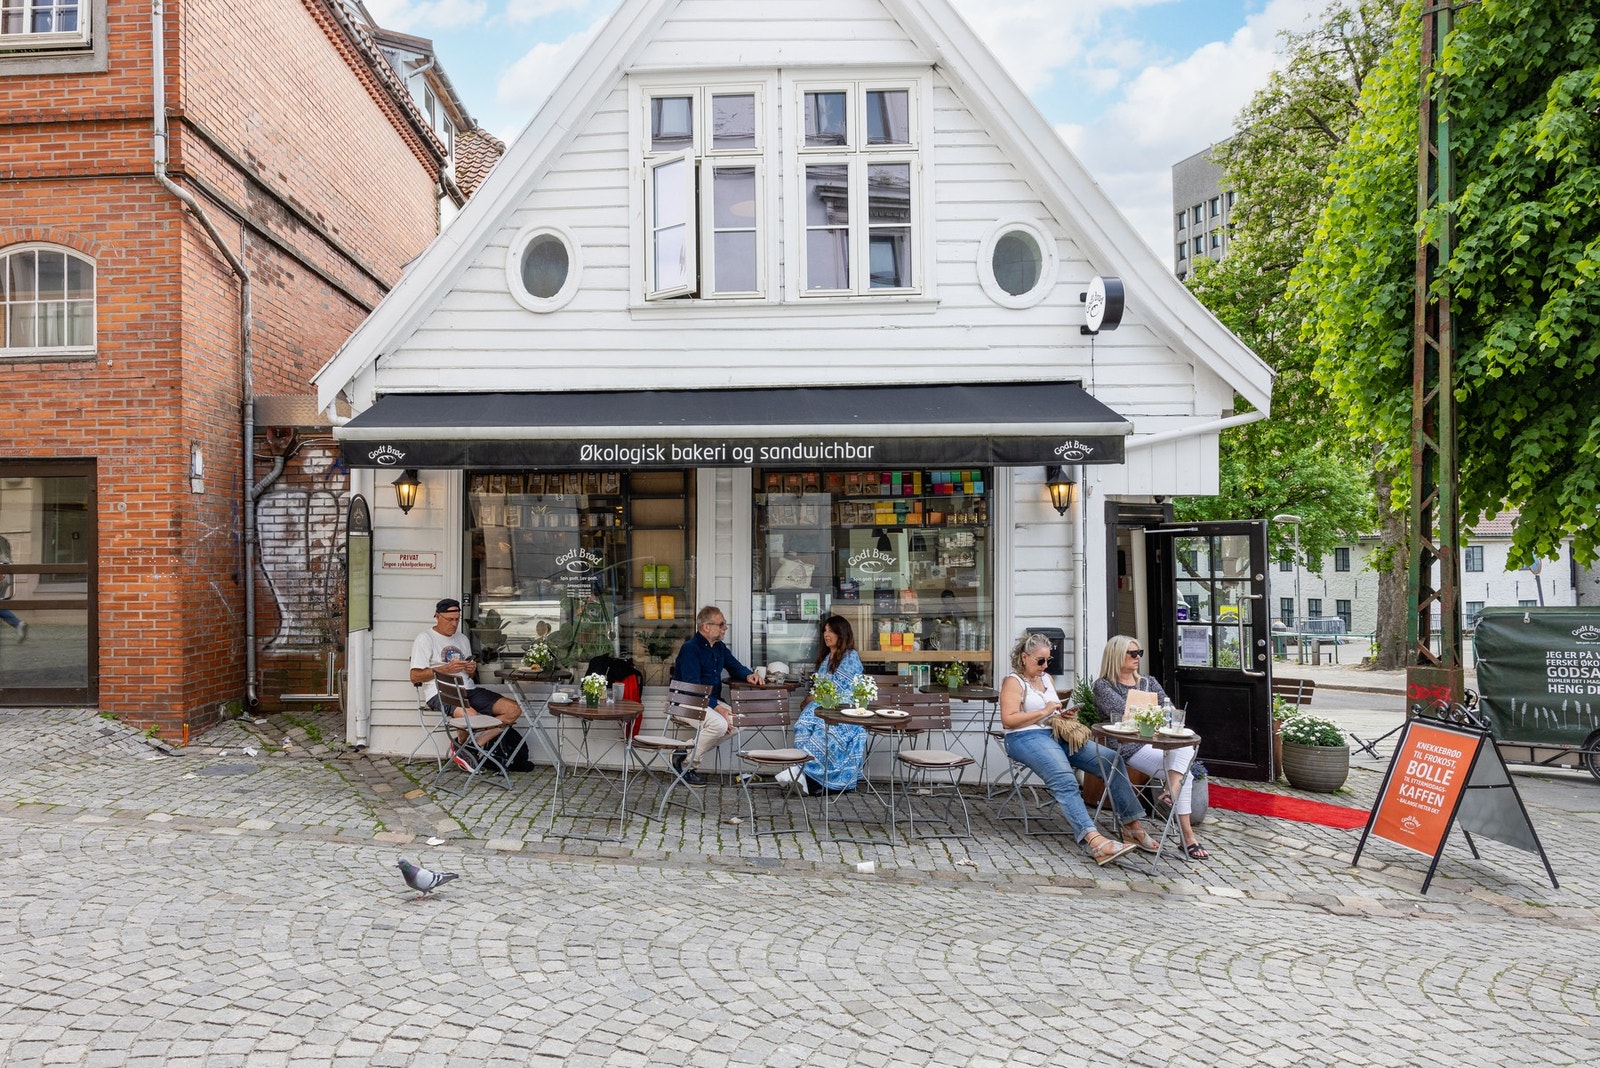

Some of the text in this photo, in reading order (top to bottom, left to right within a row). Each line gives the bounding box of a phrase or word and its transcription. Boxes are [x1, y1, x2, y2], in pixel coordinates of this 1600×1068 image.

[368, 445, 406, 459] Godt Brød
[580, 442, 875, 464] Økologisk bakeri og sandwichbar
[1054, 440, 1094, 455] Godt Brød
[555, 547, 603, 566] Godt Brød
[848, 547, 897, 566] Godt Brød
[1572, 625, 1588, 636] Godt
[1545, 651, 1562, 659] JEG
[1564, 651, 1577, 659] ER
[1579, 650, 1593, 659] PÅ
[1546, 659, 1600, 667] FERSKE ØKO
[1547, 666, 1600, 678] GODSA
[1548, 684, 1583, 695] HENG
[1416, 741, 1462, 759] KNEKKEBRØD
[1413, 750, 1456, 769] TIL FROKOST,
[1406, 760, 1454, 786] BOLLE
[1399, 783, 1445, 808] KAFFEN
